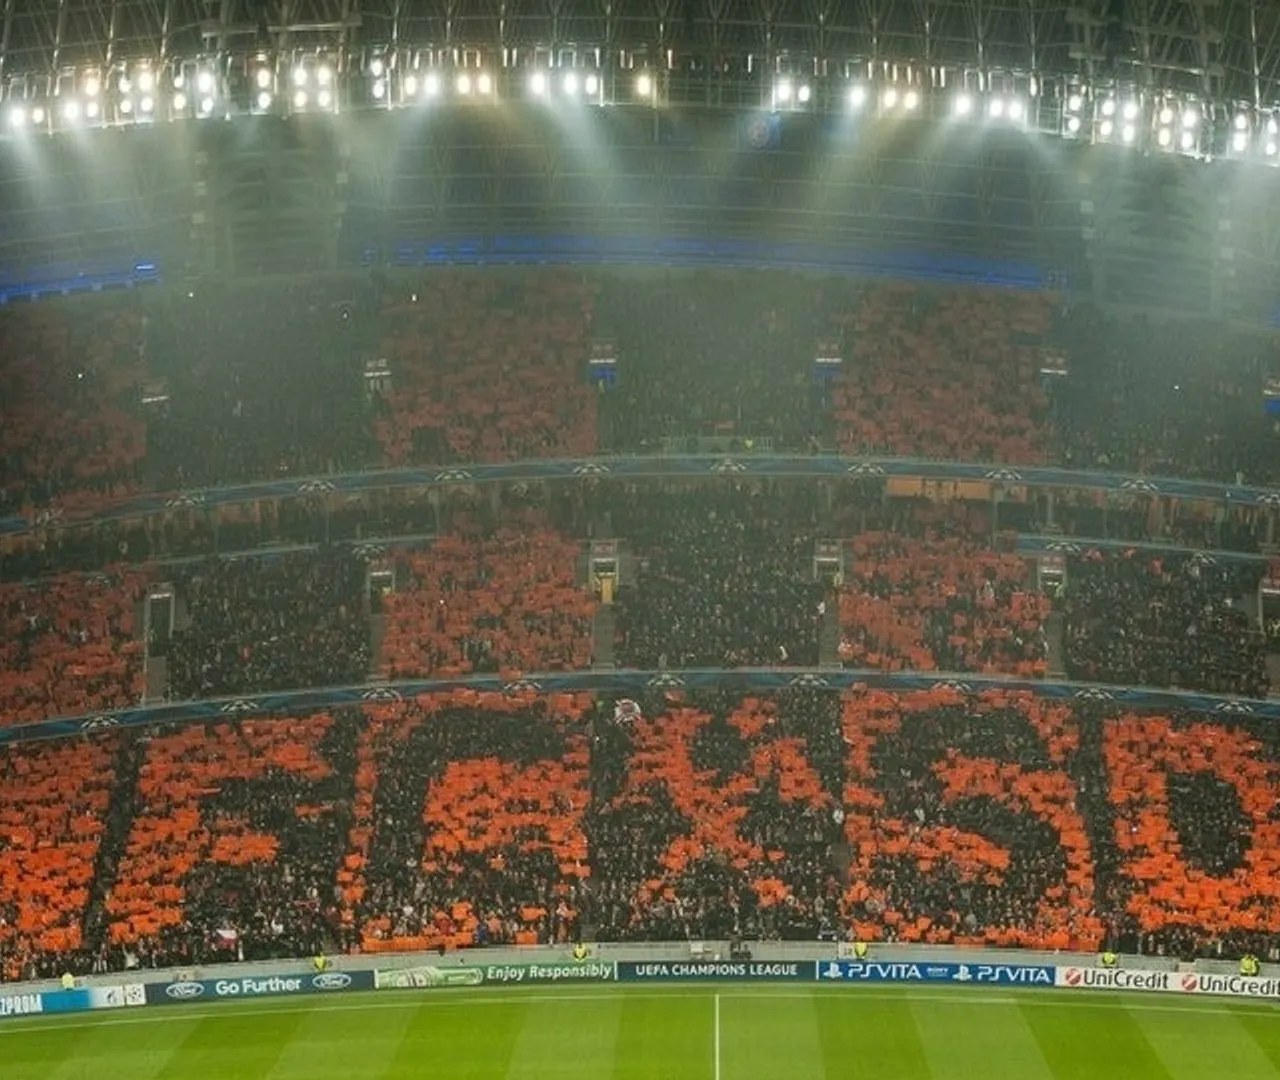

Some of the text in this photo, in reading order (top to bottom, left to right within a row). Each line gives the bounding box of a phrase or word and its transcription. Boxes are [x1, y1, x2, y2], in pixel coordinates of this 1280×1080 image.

[487, 962, 612, 981] Enjoy Responsibly
[636, 963, 798, 976] UEFA CHAMPIONS LEAGUE
[1083, 967, 1169, 989] UniCredit
[215, 976, 301, 995] Go Further
